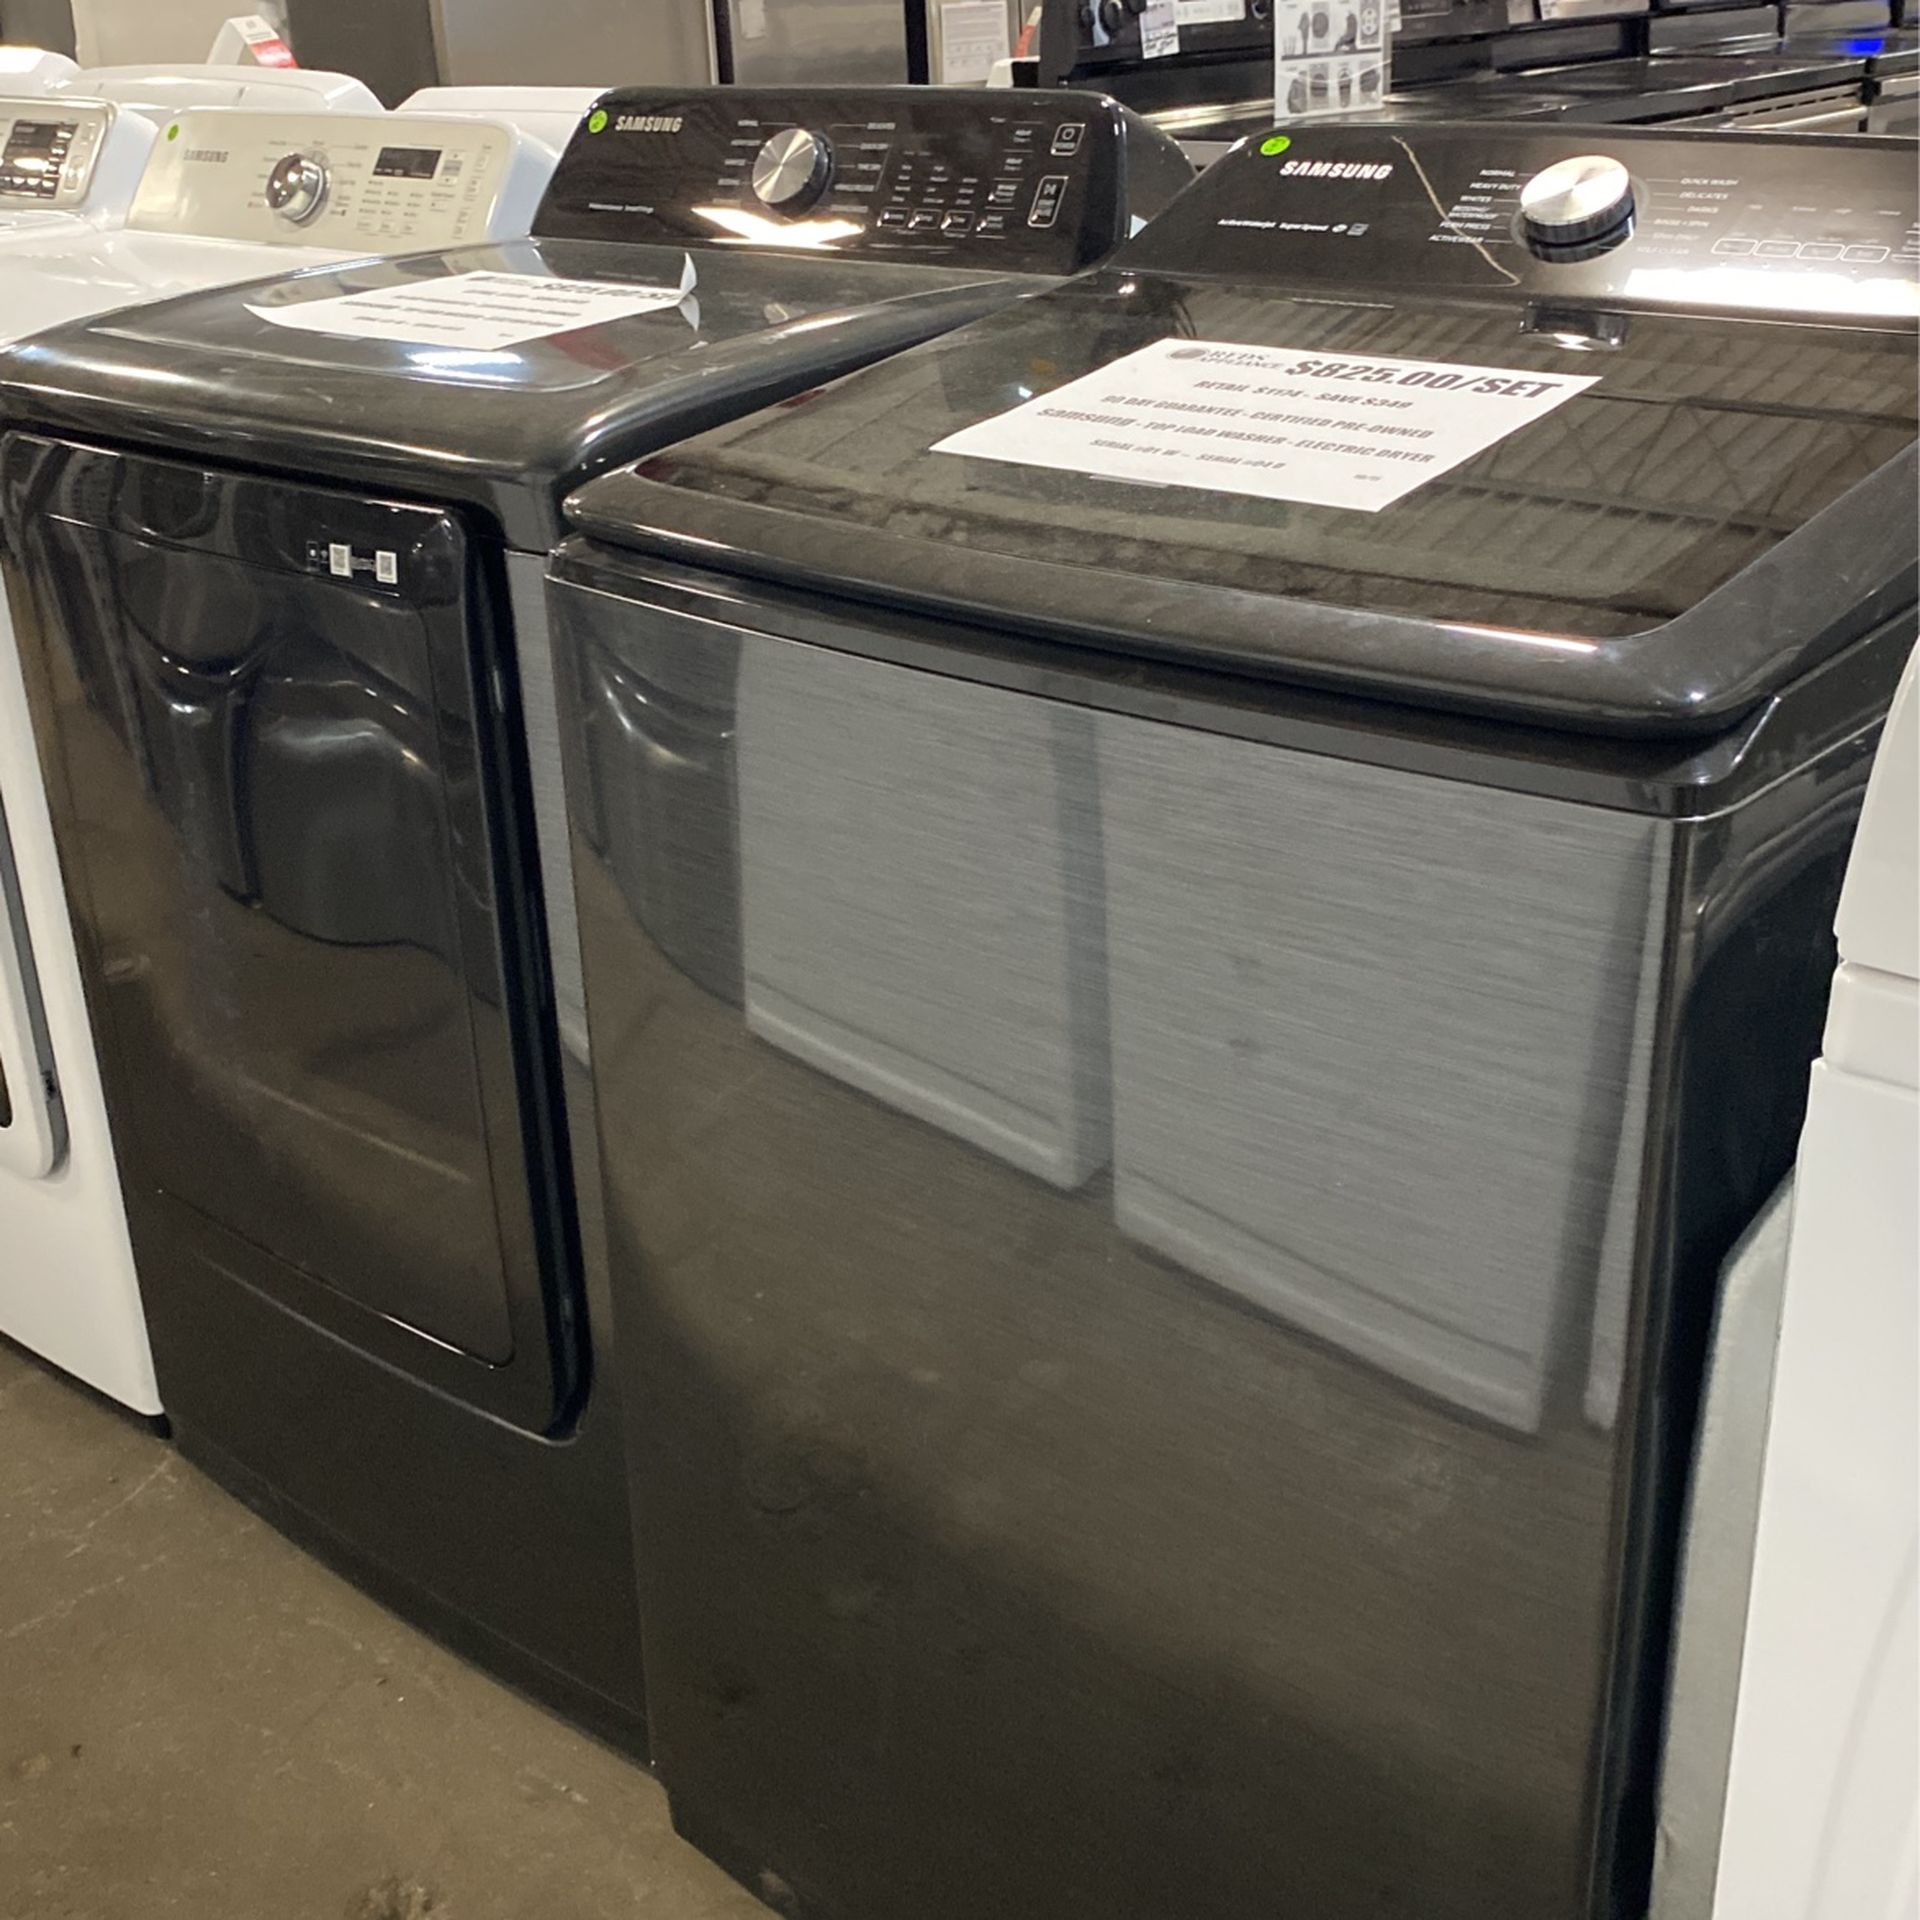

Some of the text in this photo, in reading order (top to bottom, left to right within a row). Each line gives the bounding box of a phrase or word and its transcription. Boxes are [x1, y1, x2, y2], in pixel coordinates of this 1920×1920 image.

[615, 116, 683, 132] SAMSUNG
[183, 149, 230, 163] SAMSUNG
[1279, 161, 1394, 180] SAMSUNG
[1285, 360, 1563, 398] $825.00/SET
[1193, 380, 1250, 393] RETAIL
[1314, 392, 1363, 405] SAVE
[1125, 396, 1156, 406] DAY
[1153, 399, 1244, 418] GUARANTEE
[1249, 410, 1332, 427] CERTIFIED
[1330, 420, 1434, 439] PRE-OWNED
[1142, 420, 1177, 433] TOP
[1173, 424, 1218, 438] LOAD
[1216, 428, 1288, 446] WASHER
[1294, 438, 1378, 456] ELECTRIC
[1373, 448, 1436, 464] DRYER
